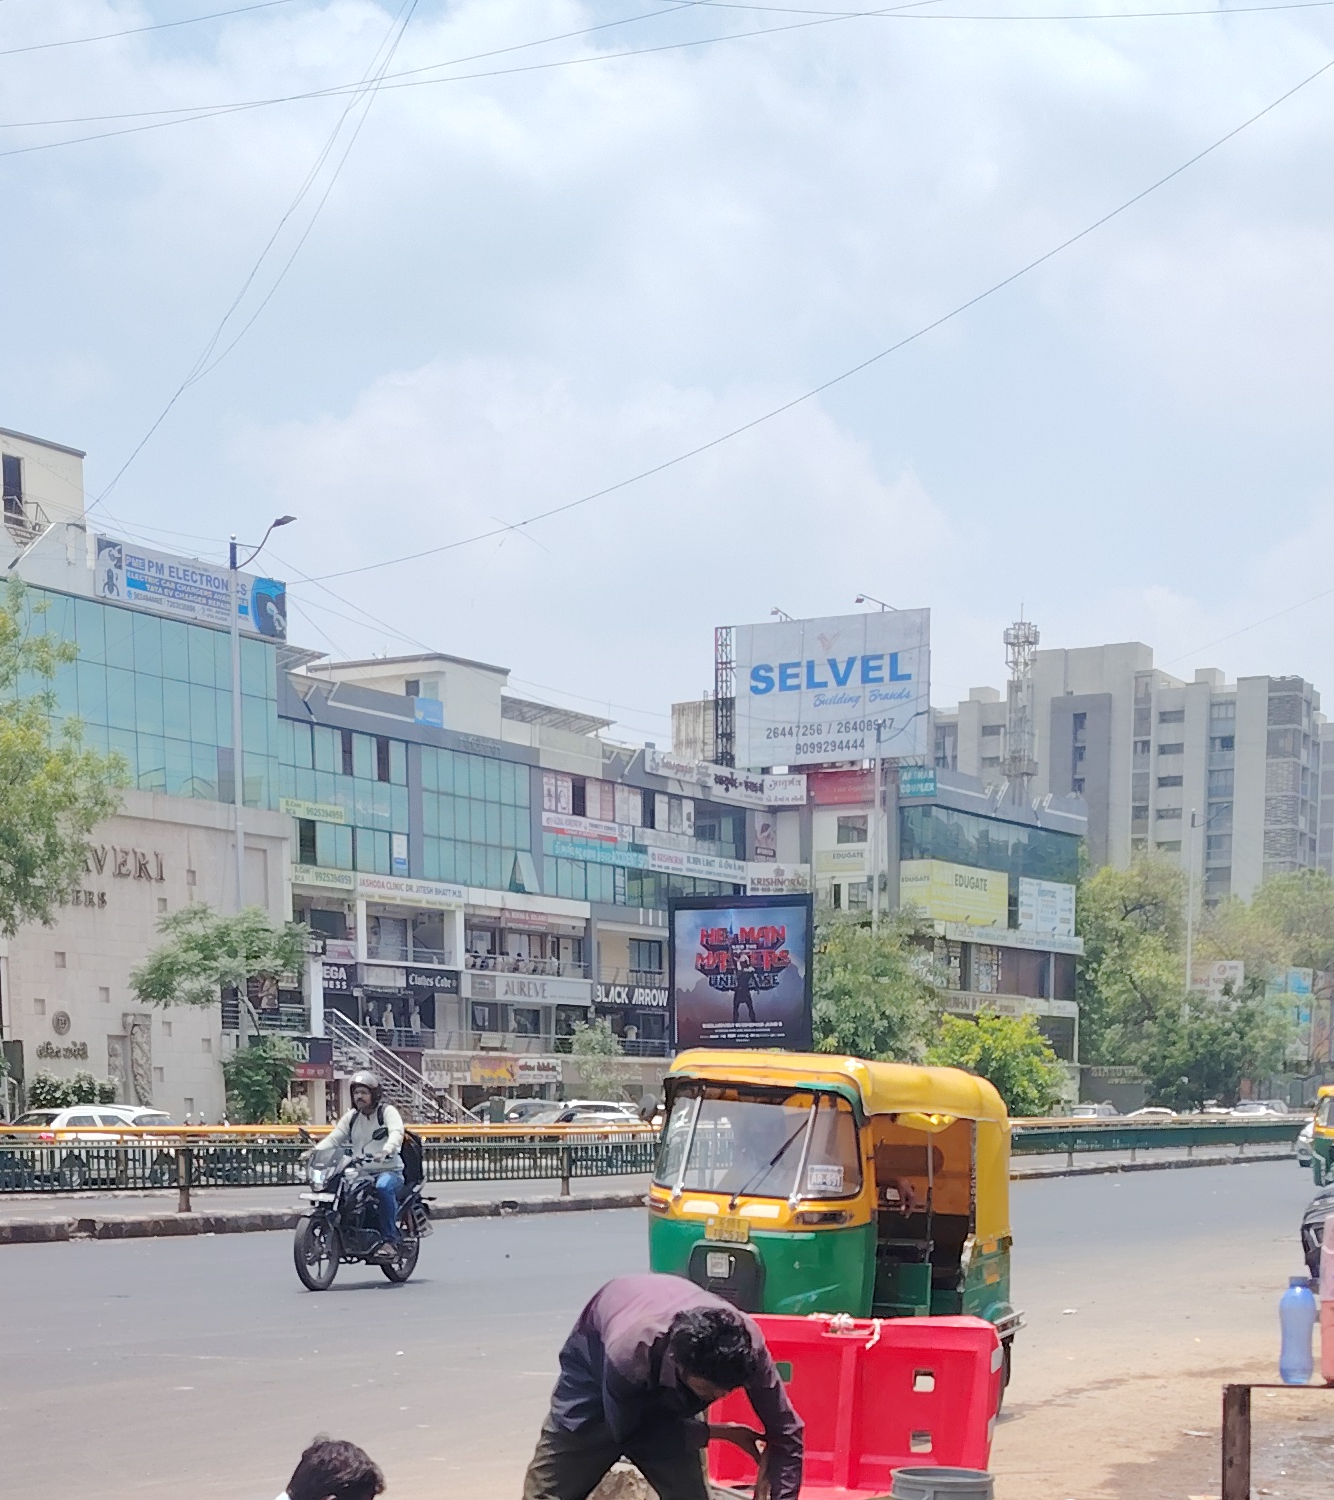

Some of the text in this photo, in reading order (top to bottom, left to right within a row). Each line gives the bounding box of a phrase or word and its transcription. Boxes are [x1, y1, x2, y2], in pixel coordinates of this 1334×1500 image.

[147, 559, 165, 577] PM
[168, 565, 248, 597] ELECTRONS
[749, 651, 913, 696] SELVEL
[813, 688, 913, 709] Building Brands
[766, 723, 823, 740] 26447256
[832, 851, 865, 861] EDUGATE
[386, 880, 405, 893] CLINIC
[901, 875, 931, 884] EDUGATE
[954, 873, 988, 893] EDUGATE
[323, 965, 347, 981] EGA
[408, 973, 452, 989] Clothes Code
[502, 979, 548, 1000] AUREVE
[595, 984, 669, 1007] BLACK ARROW
